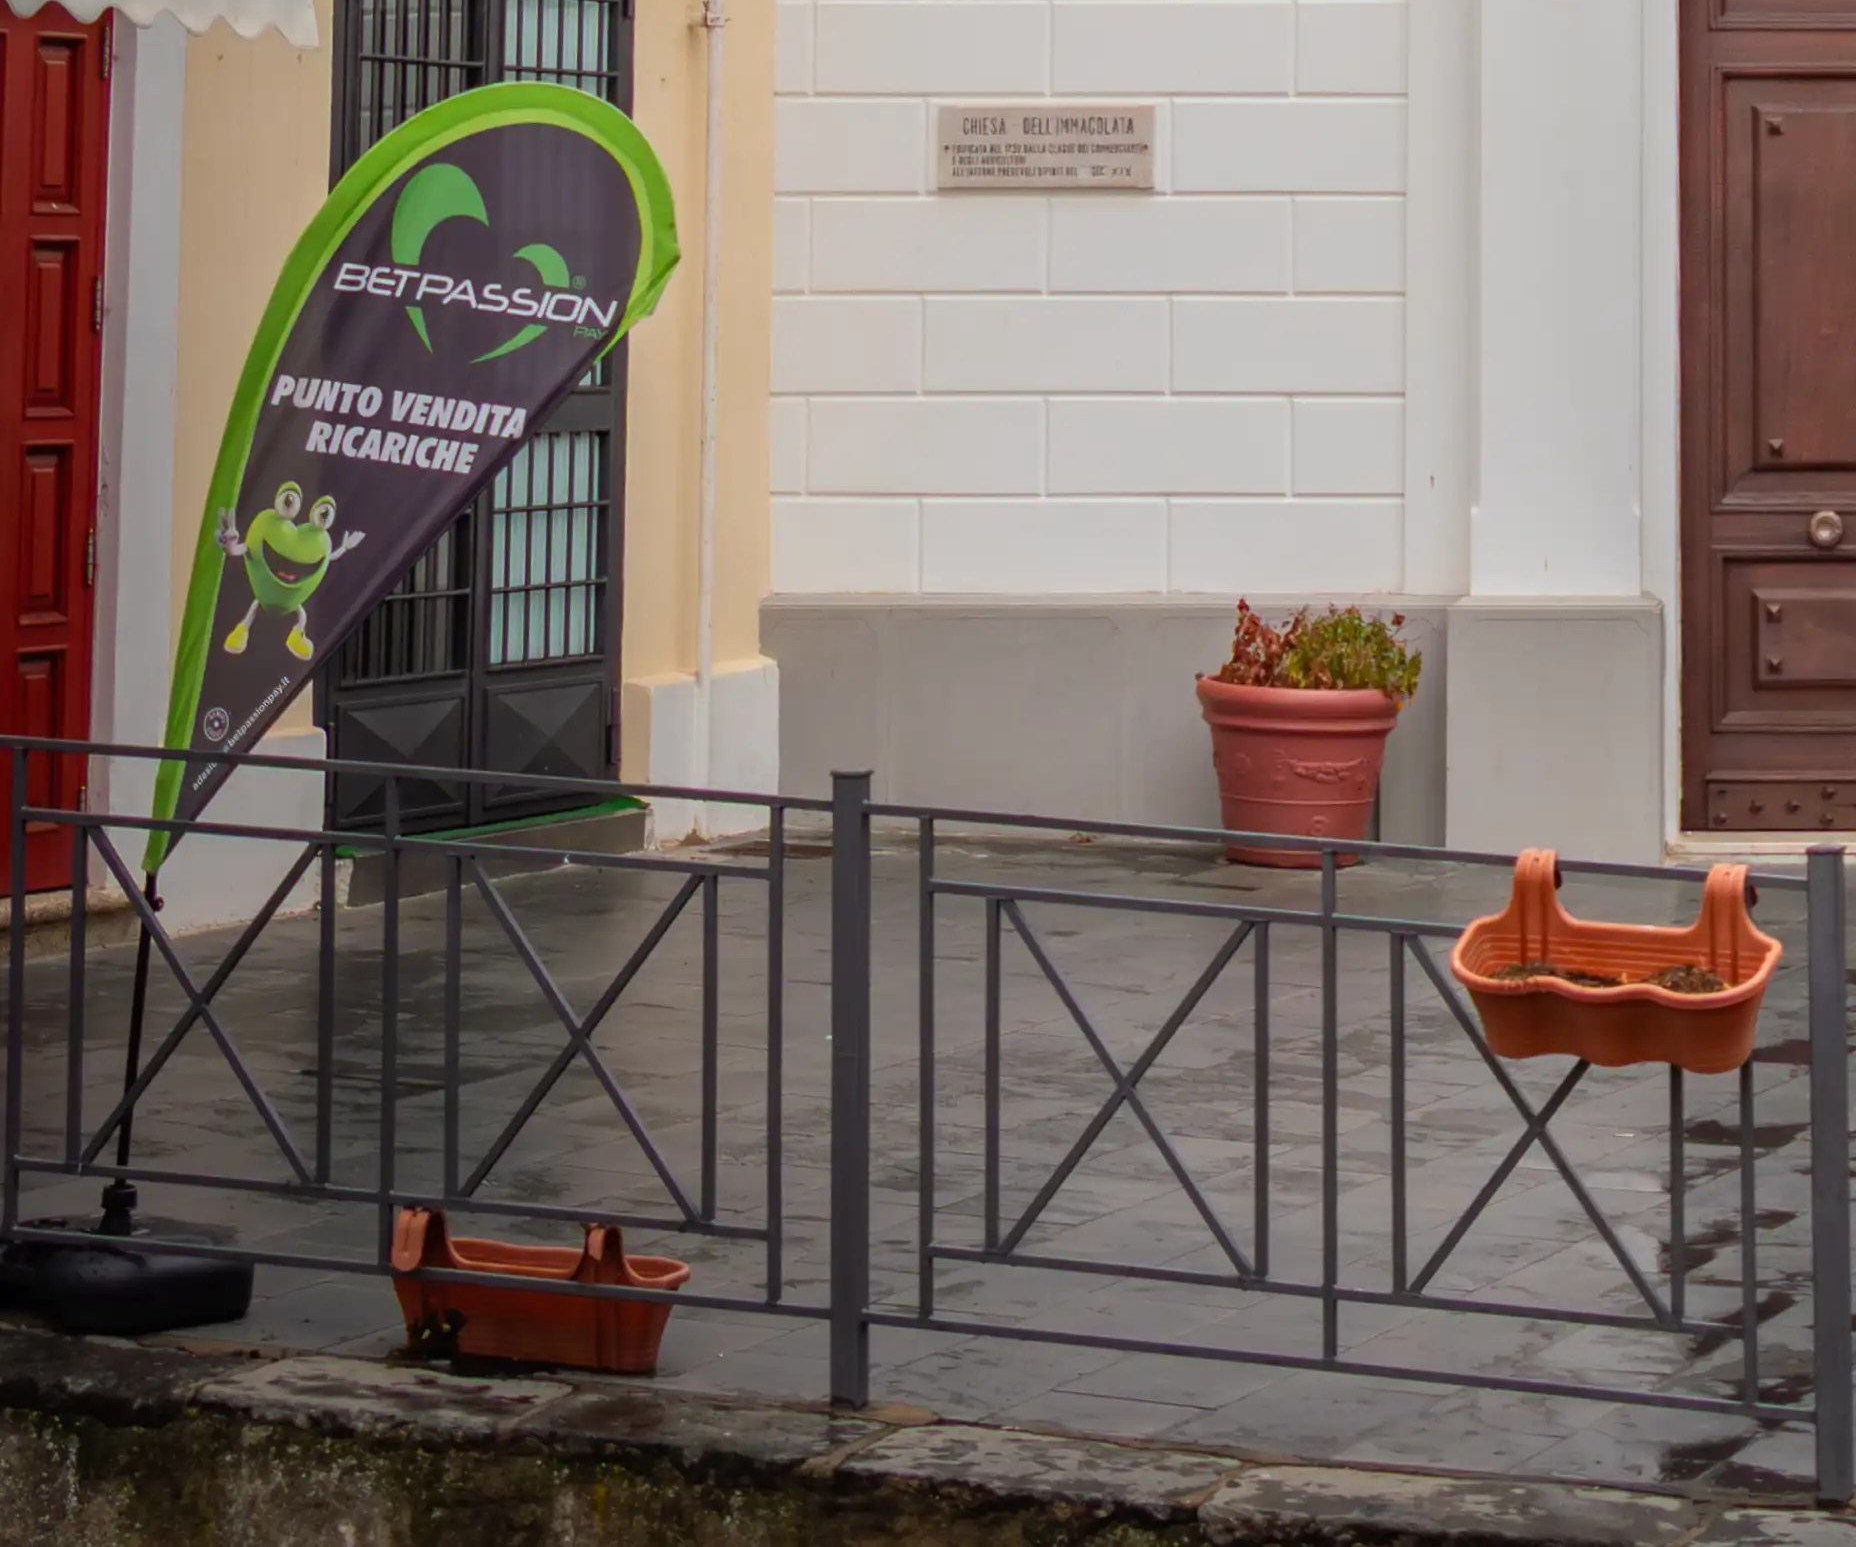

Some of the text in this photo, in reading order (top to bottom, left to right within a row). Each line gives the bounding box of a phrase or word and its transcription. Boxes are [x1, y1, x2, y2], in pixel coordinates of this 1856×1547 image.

[962, 116, 1006, 136] CHIESA
[333, 262, 618, 328] BETPASSION
[573, 326, 606, 339] PAY
[271, 374, 527, 439] PUNTO VENDITA
[305, 420, 479, 474] RICARICHE
